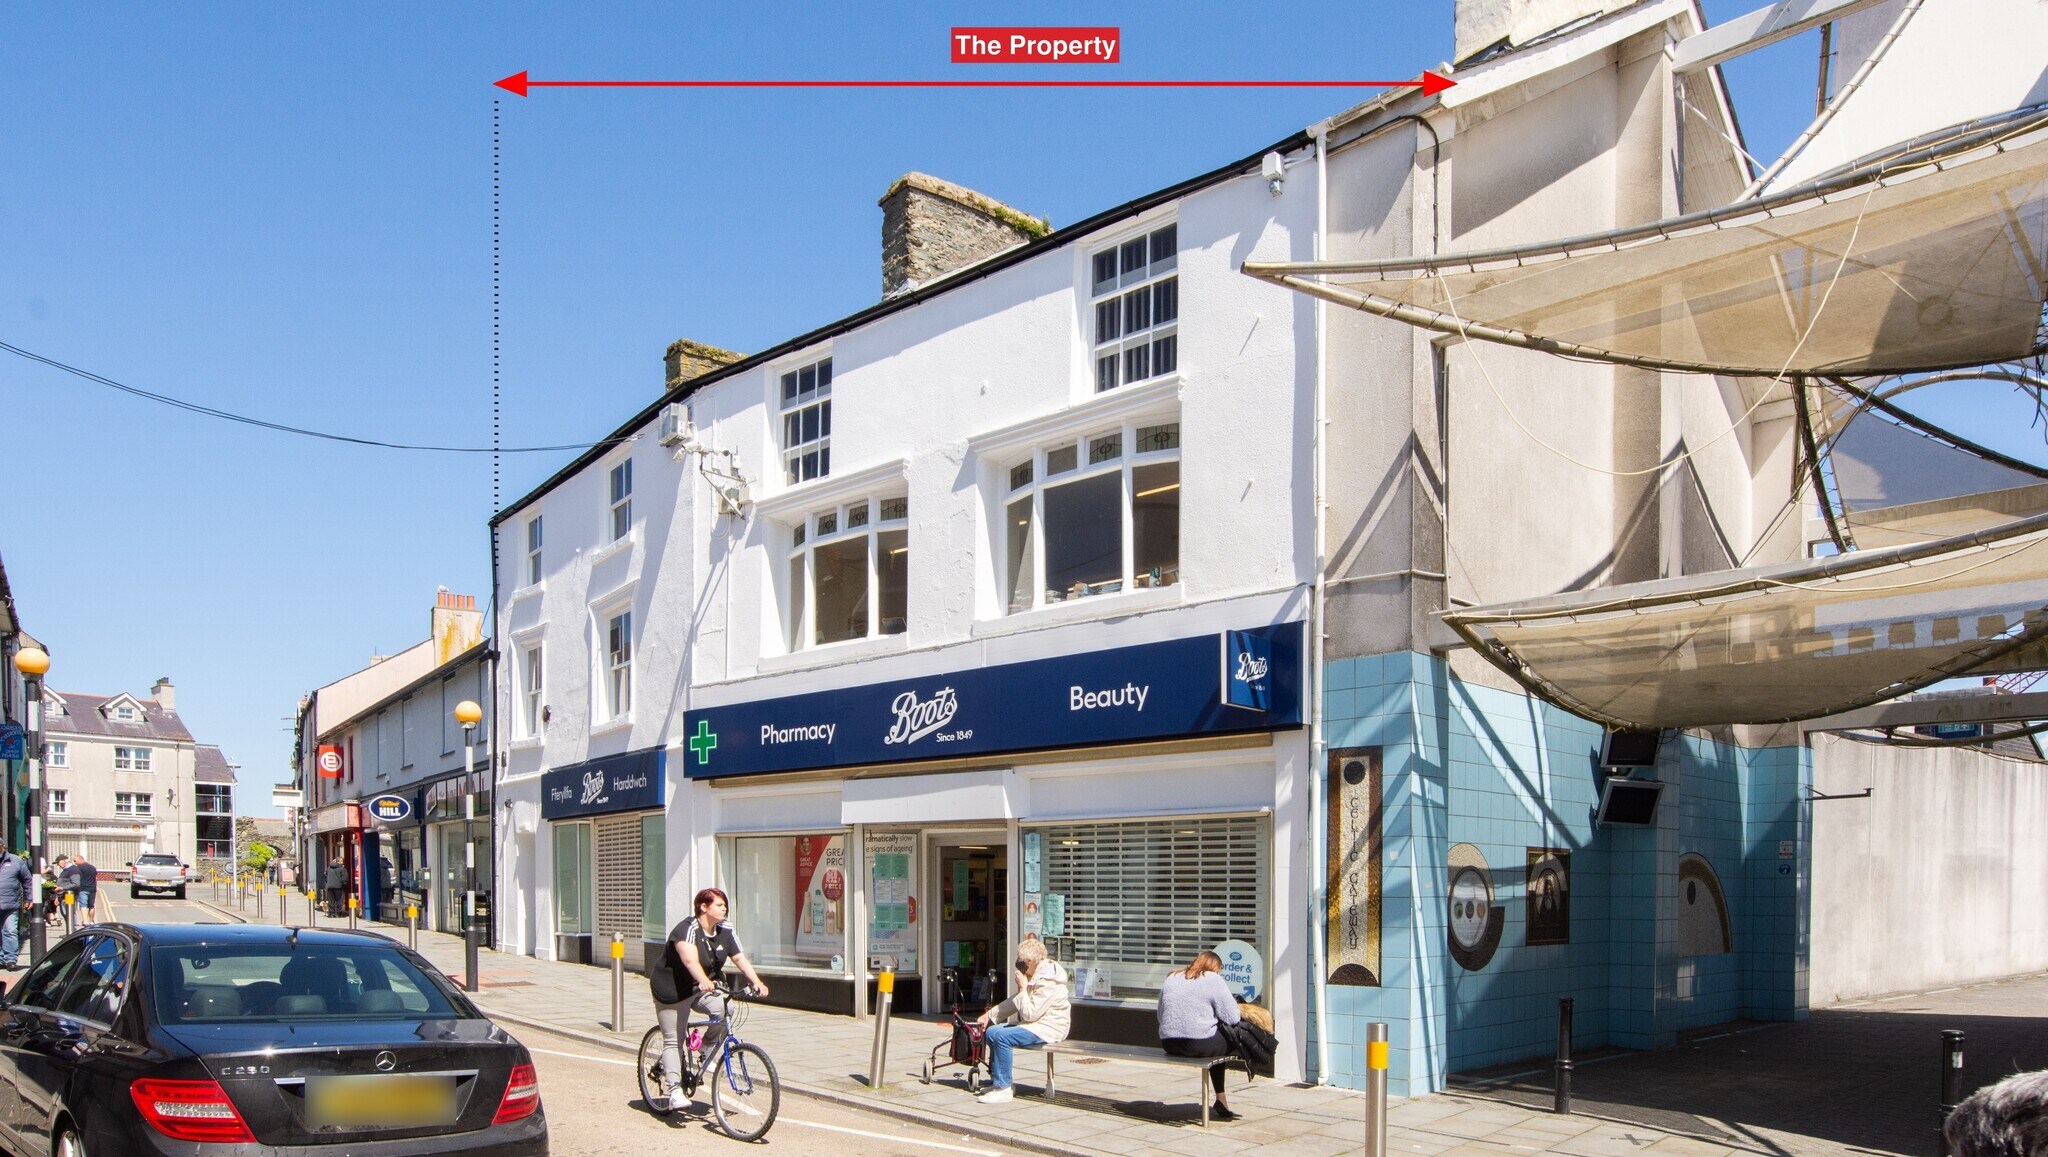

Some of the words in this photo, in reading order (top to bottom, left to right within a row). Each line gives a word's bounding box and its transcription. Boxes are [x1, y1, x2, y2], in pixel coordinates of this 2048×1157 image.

[1235, 652, 1268, 683] Boots
[1070, 682, 1149, 712] Beauty
[884, 686, 958, 746] Boots
[761, 723, 836, 745] Pharmacy
[936, 732, 955, 743] Since
[956, 729, 973, 741] 1849
[580, 770, 605, 805] Boots
[613, 772, 647, 791] Harddwch
[551, 785, 573, 804] Fferyllfa
[379, 807, 401, 816] HILL
[1349, 797, 1360, 863] CELTIC
[871, 845, 886, 853] signs
[894, 845, 913, 854] ageing
[1348, 873, 1359, 950] GATEWAY
[1245, 964, 1252, 973] &
[221, 1067, 231, 1075] C
